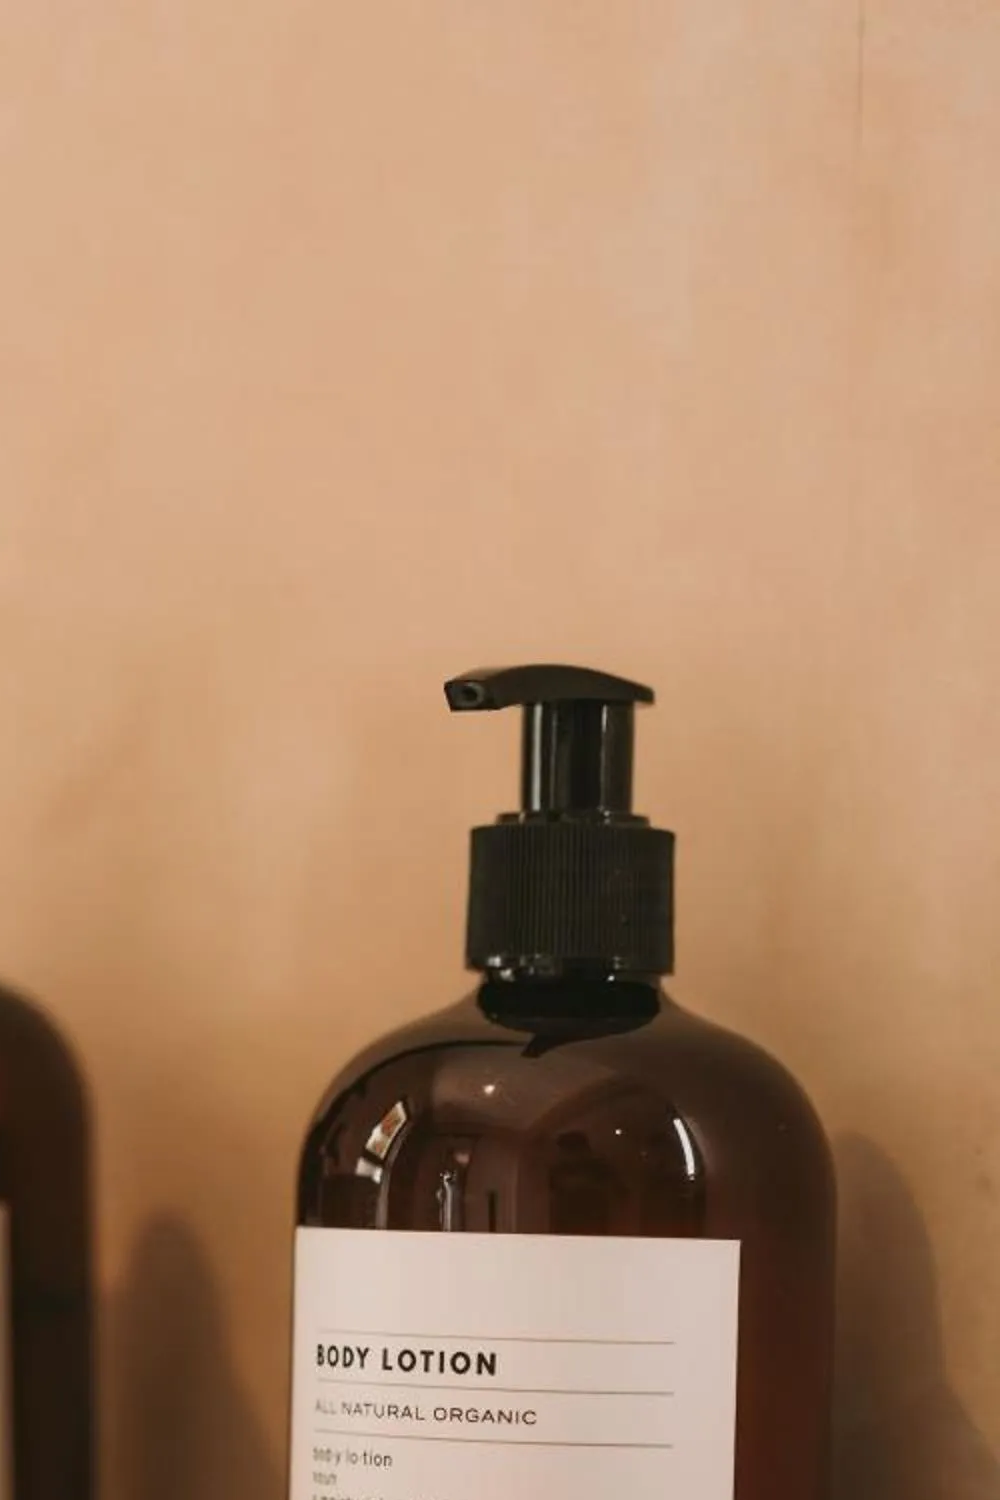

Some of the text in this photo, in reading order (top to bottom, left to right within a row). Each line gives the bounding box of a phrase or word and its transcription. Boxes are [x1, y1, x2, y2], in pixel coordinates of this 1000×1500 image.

[316, 1344, 497, 1376] BODY LOTION
[315, 1400, 538, 1426] ALL NATURAL ORGANIC
